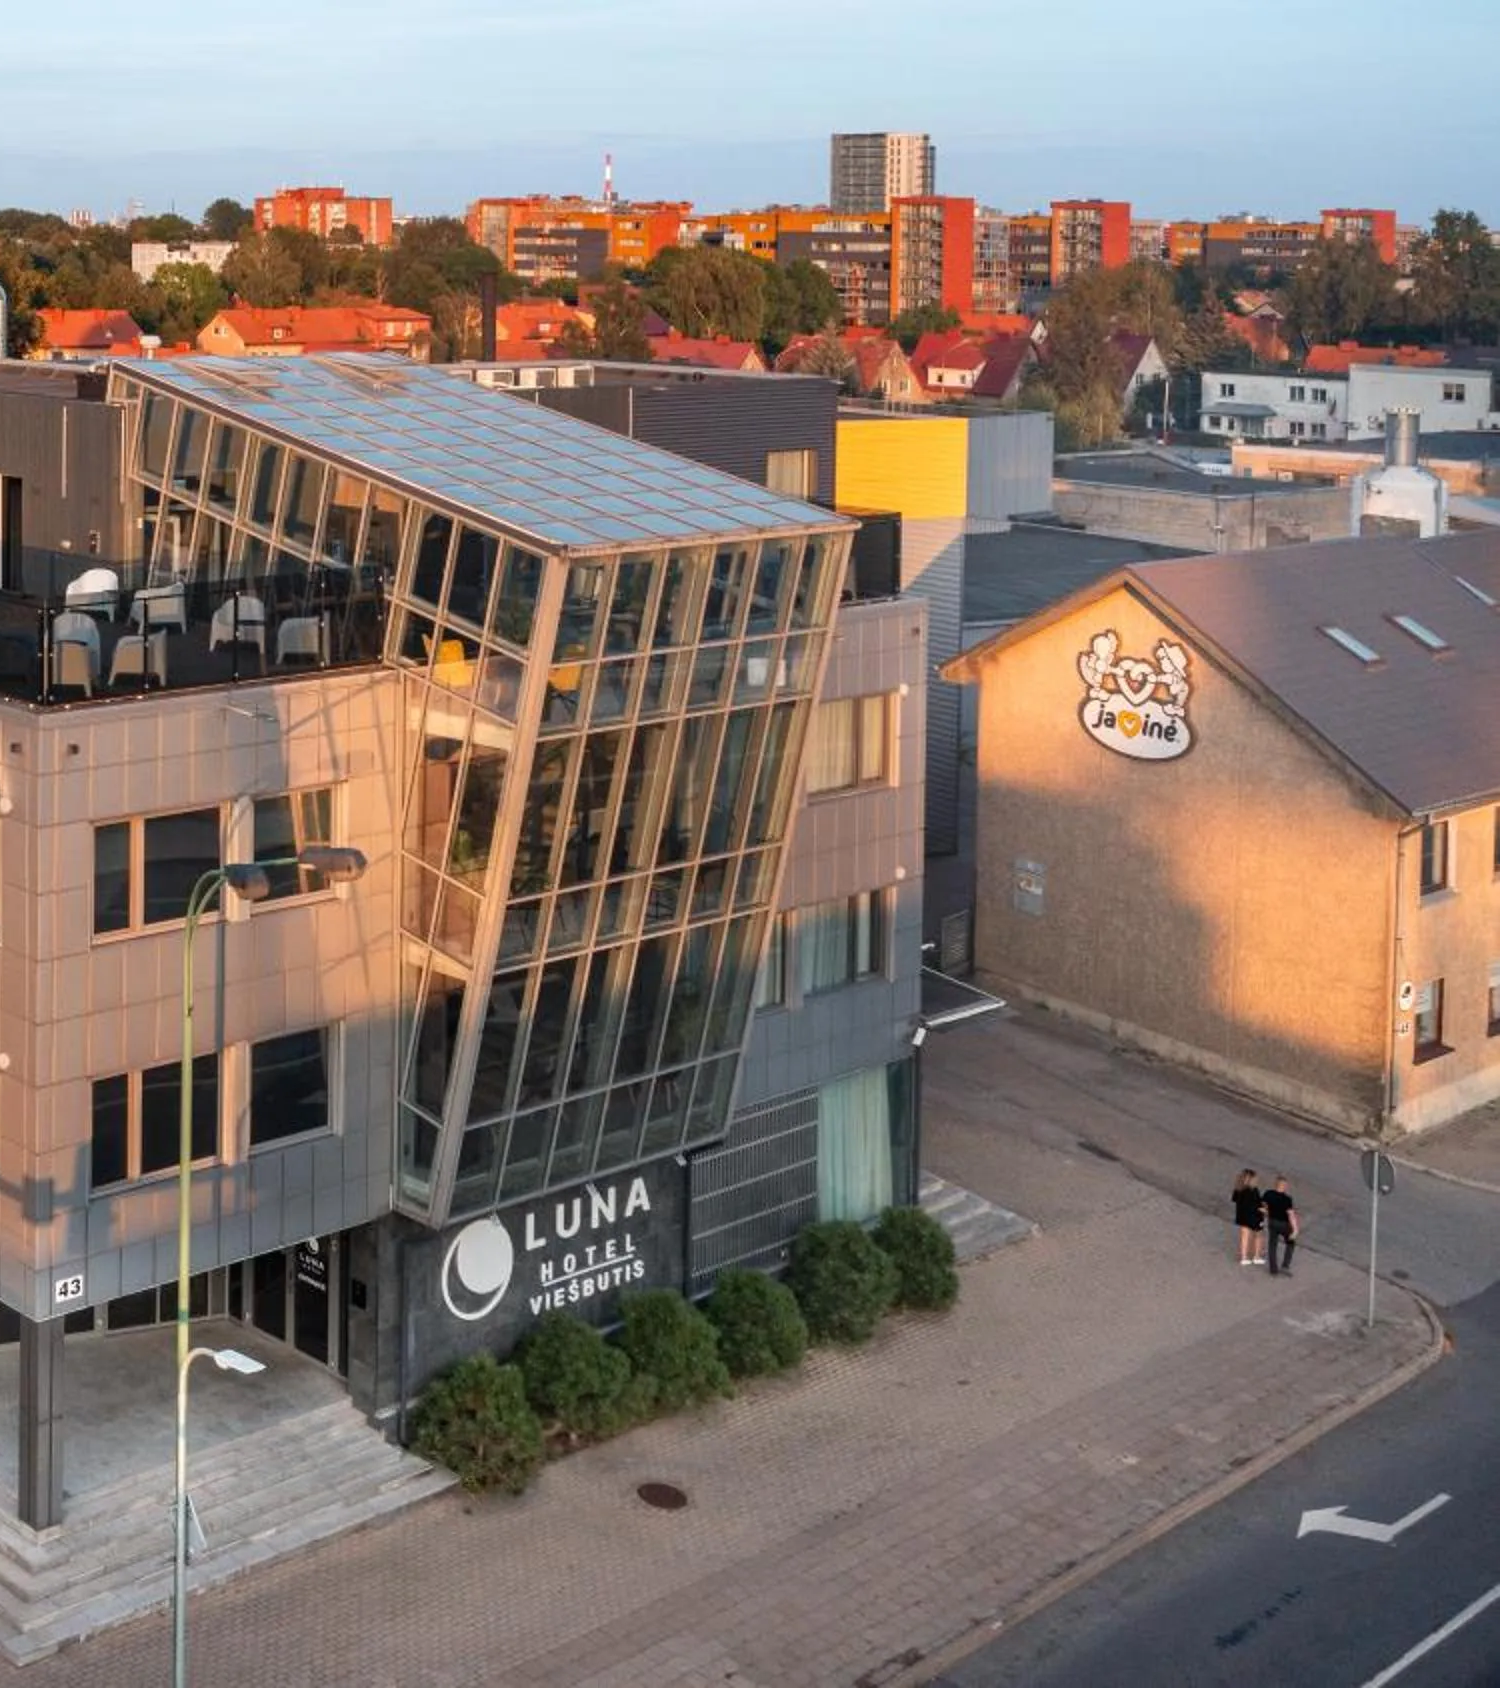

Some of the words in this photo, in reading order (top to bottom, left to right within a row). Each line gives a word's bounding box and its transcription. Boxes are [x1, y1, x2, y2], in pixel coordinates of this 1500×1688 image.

[525, 1177, 650, 1250] LUNA
[541, 1234, 636, 1283] HOTEL
[59, 1279, 81, 1296] 43
[529, 1260, 645, 1315] VIEŠBUTIS
